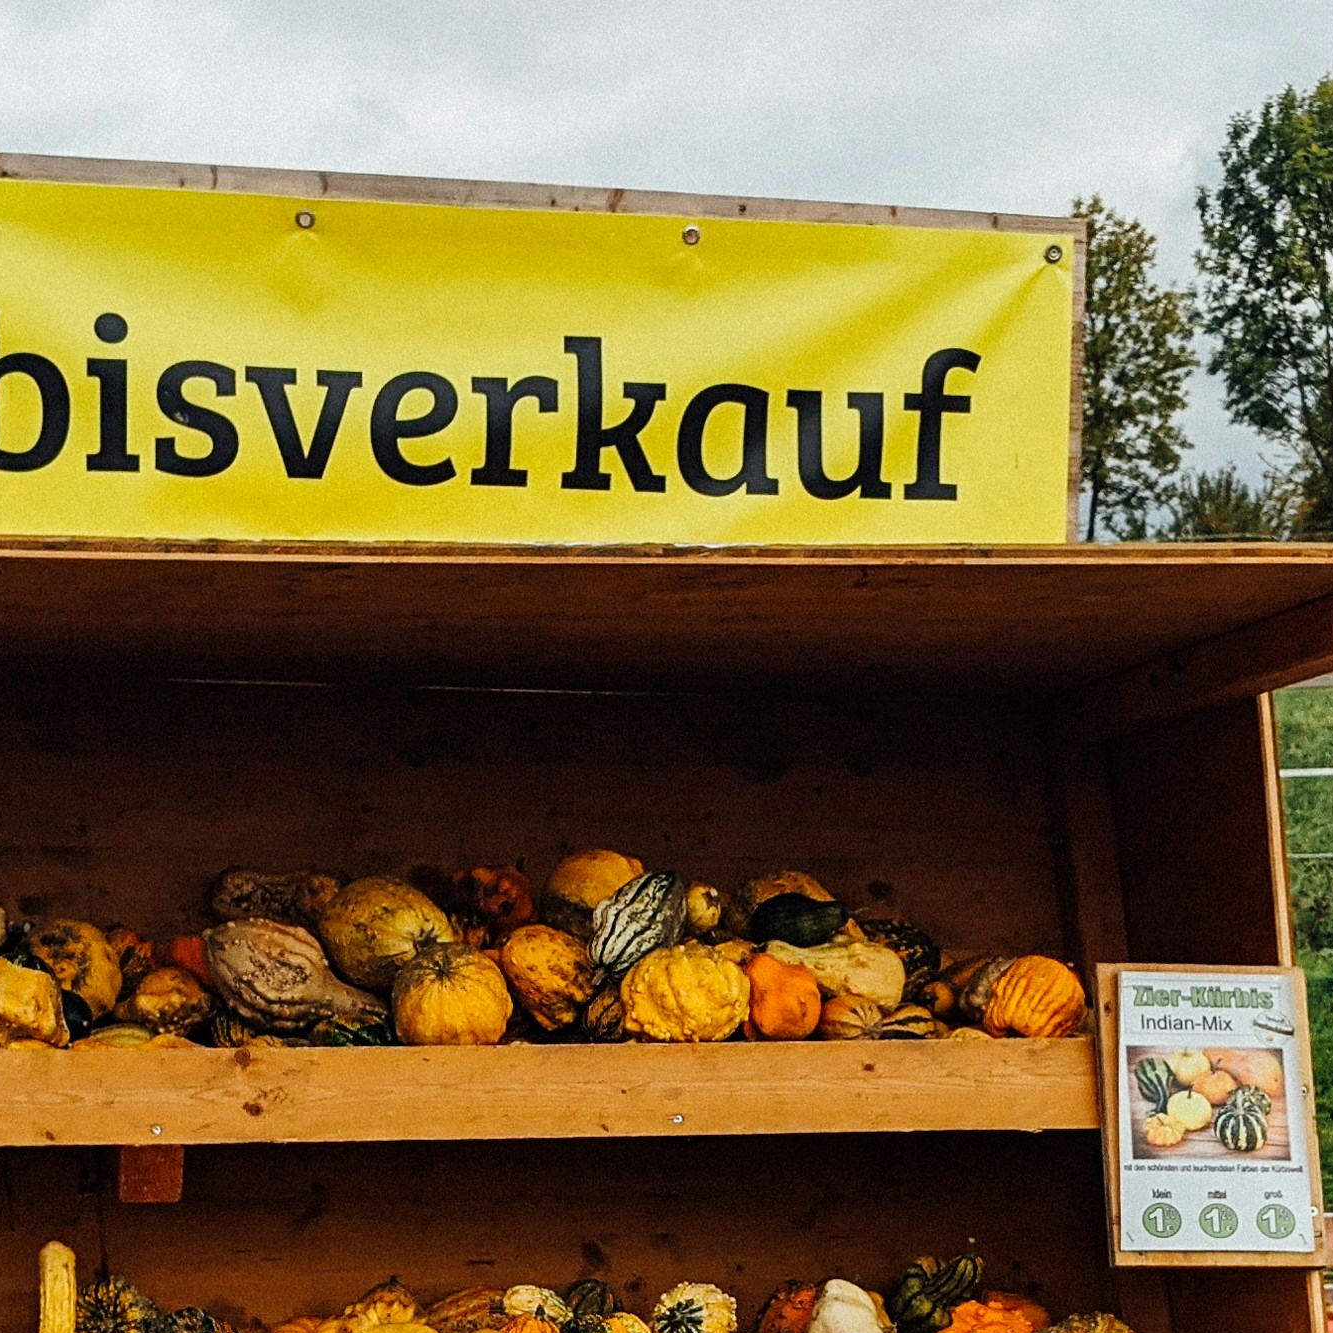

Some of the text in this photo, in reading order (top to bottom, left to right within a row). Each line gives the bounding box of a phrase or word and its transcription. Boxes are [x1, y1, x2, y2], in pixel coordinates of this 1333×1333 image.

[1132, 984, 1274, 1009] Zier-Kürbis
[1140, 1014, 1234, 1032] Indian-Mix
[1180, 1164, 1192, 1172] und
[1237, 1164, 1259, 1172] Farben
[1152, 1188, 1283, 1200] klein mittel groß
